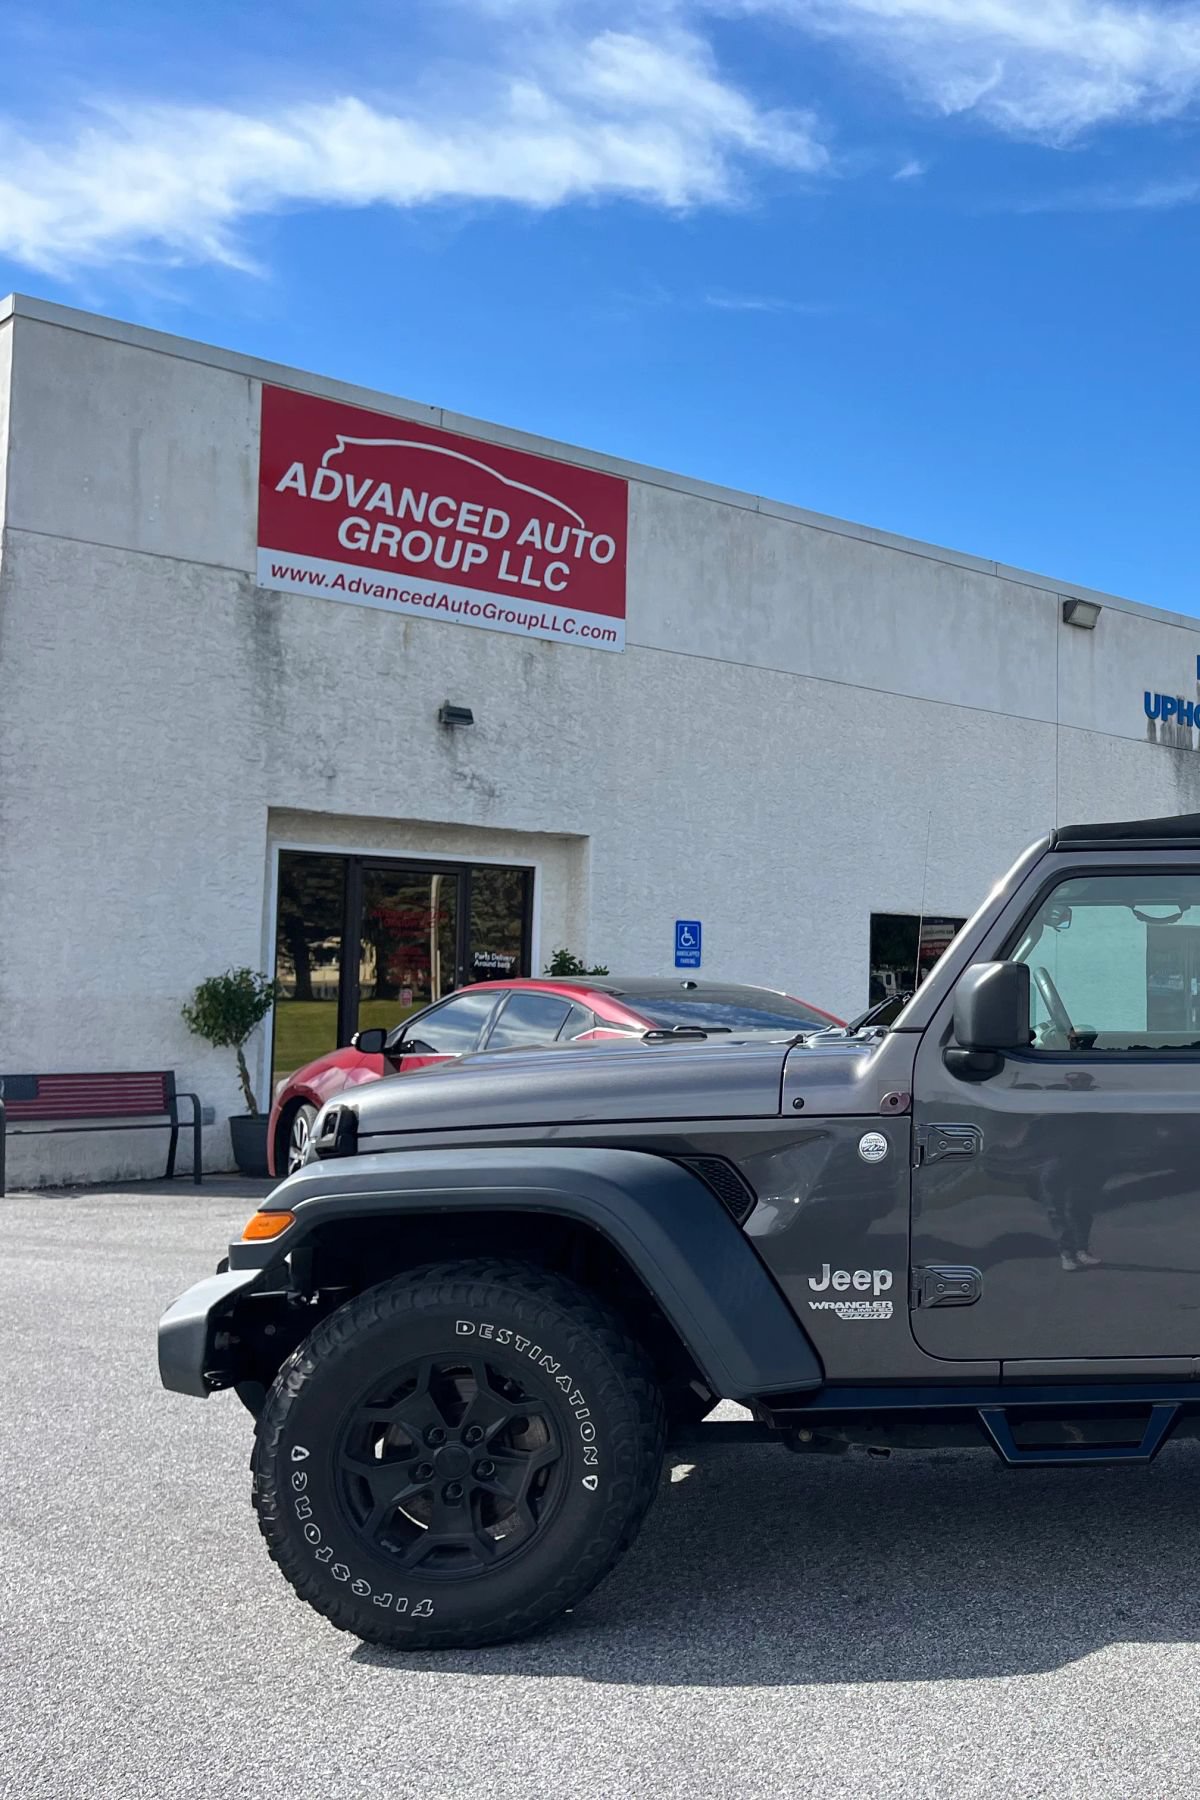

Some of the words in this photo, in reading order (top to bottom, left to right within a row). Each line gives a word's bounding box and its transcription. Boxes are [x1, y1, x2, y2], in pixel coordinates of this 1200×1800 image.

[275, 462, 511, 541] ADVANCED
[516, 518, 616, 564] AUTO
[337, 516, 489, 573] GROUP
[497, 556, 571, 592] LLC
[270, 563, 618, 643] www.AdvancedAutoGroupLLC.com
[807, 1263, 893, 1296] Jeep
[807, 1301, 894, 1309] WRANGLER
[455, 1320, 599, 1466] DESTINATION
